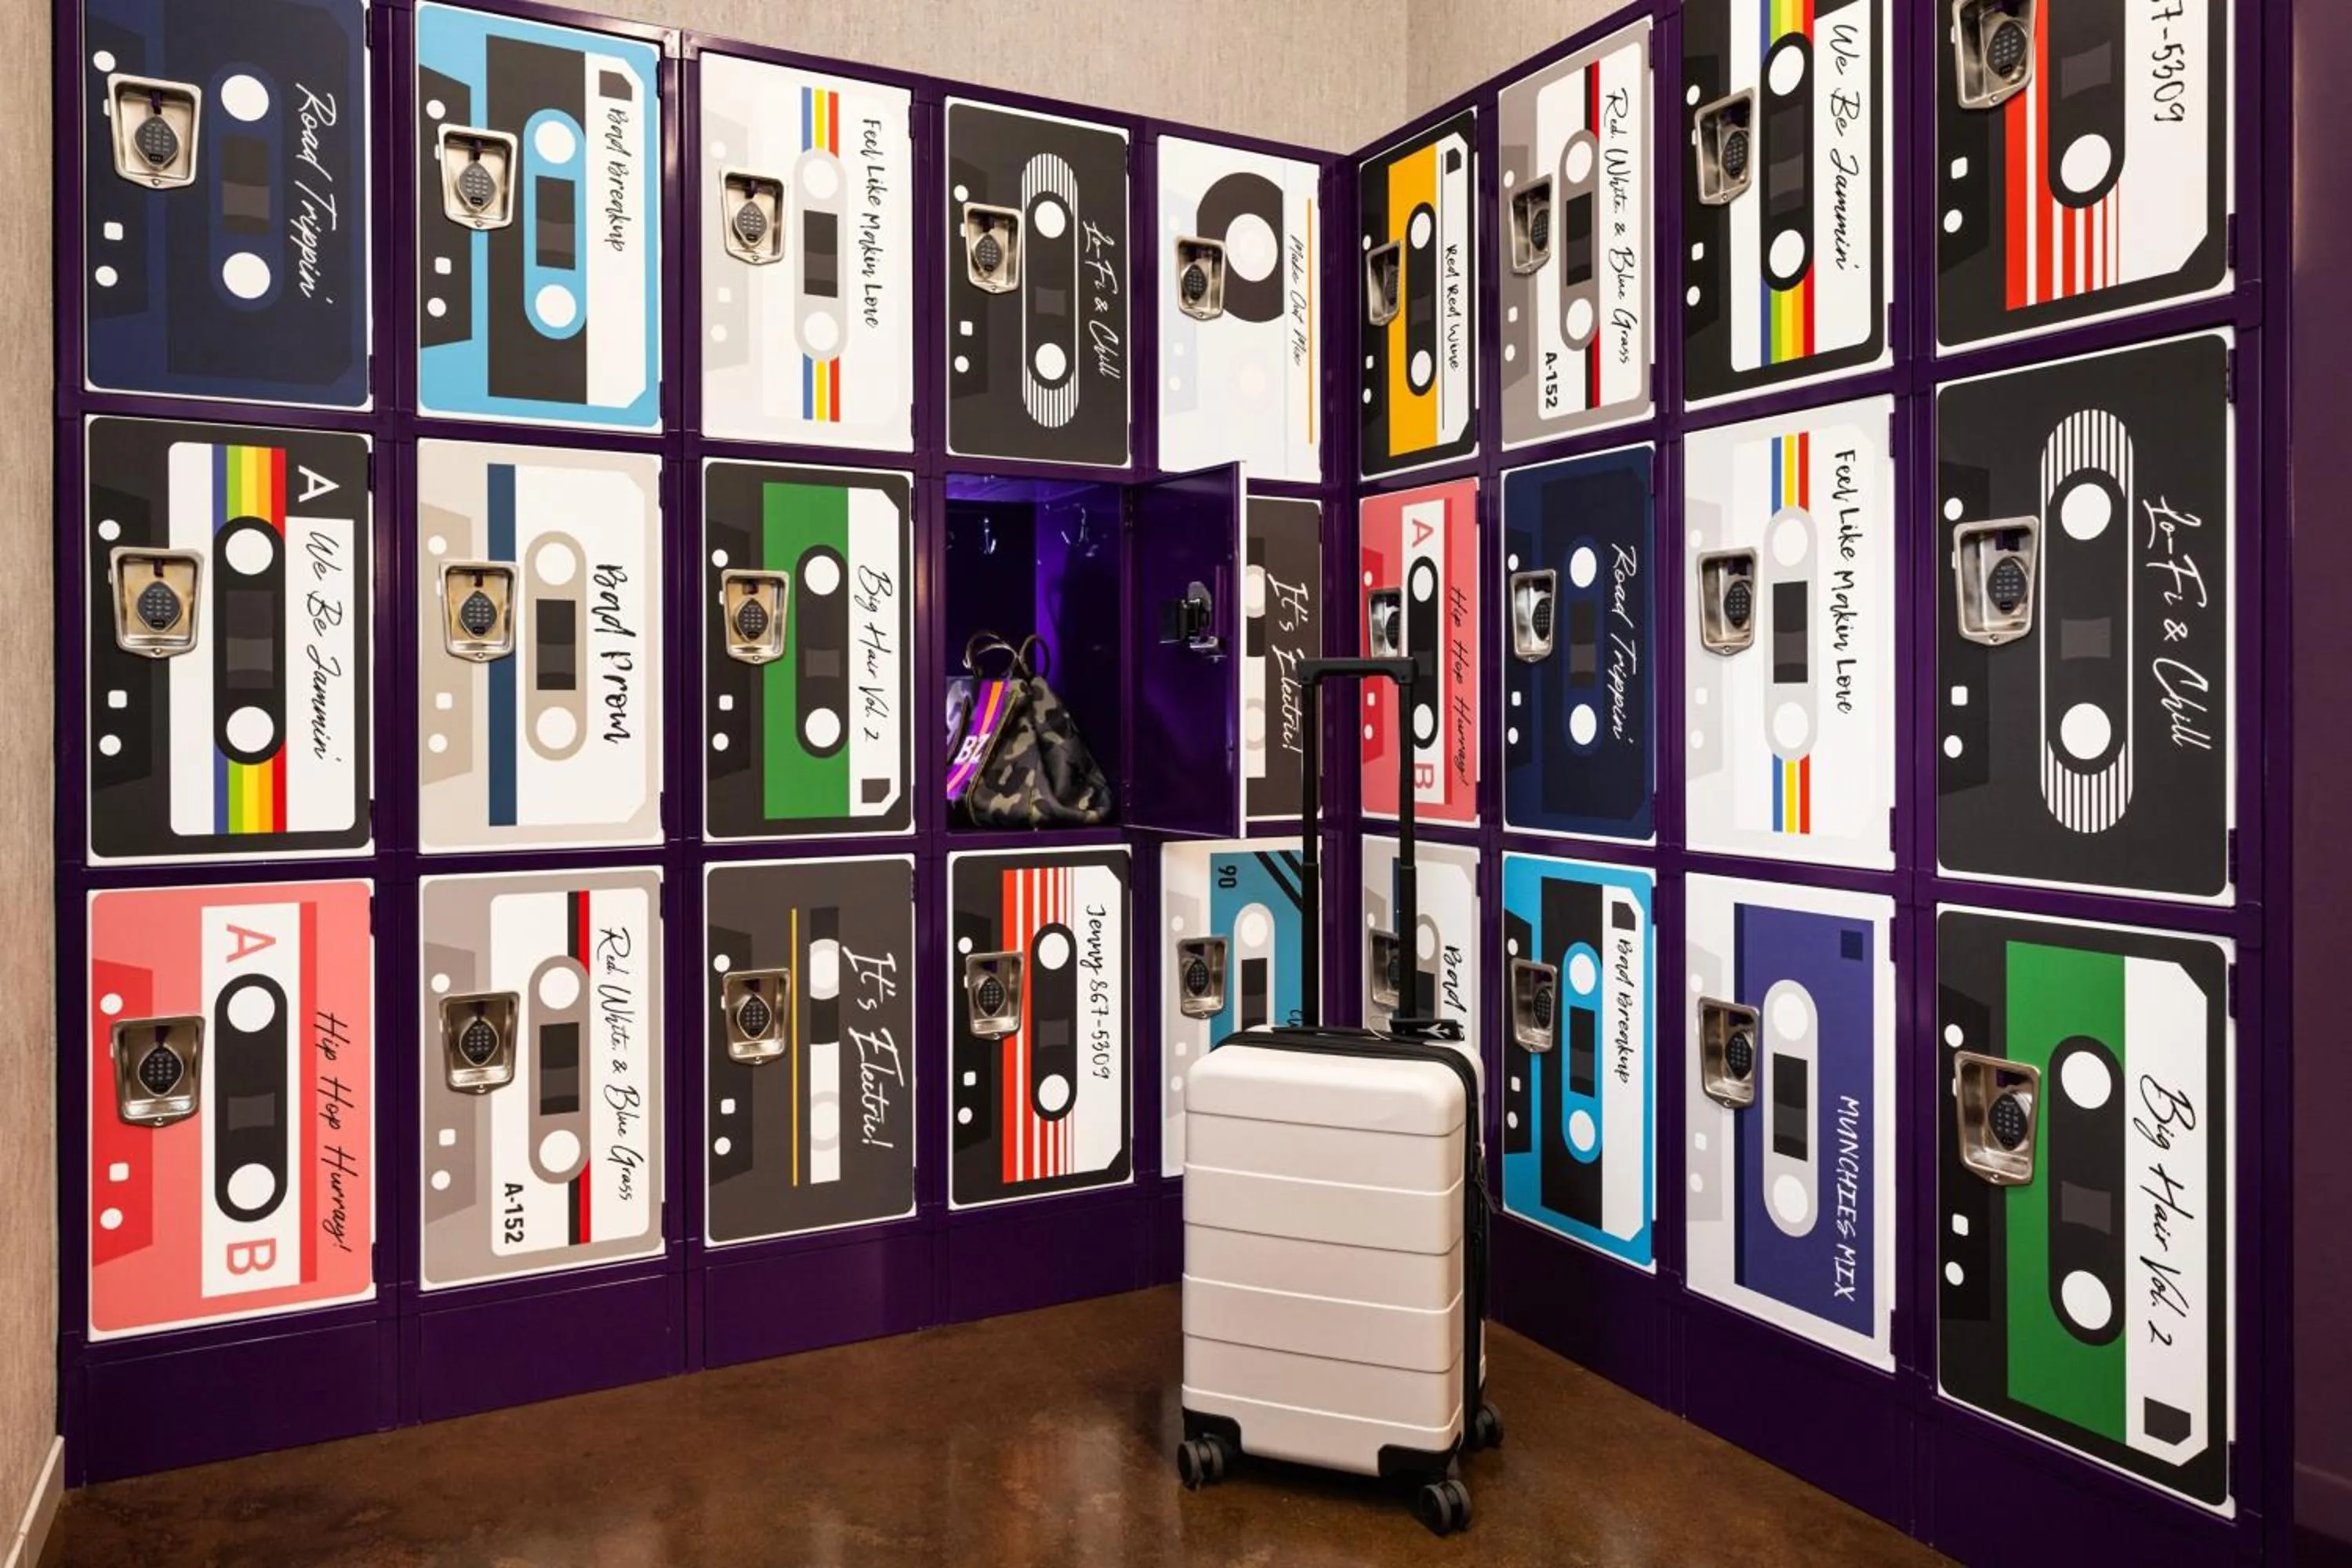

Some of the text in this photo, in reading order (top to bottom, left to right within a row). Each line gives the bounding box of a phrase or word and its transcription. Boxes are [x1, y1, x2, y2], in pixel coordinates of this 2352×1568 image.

[2151, 0, 2185, 122] 7-5309
[290, 83, 337, 303] Road Trippin'
[604, 108, 632, 251] Bad Breakup
[1830, 25, 1860, 270] We Be Jammin'
[858, 119, 888, 326] Feel Like Makin Love
[1607, 246, 1635, 299] Blue
[1615, 223, 1625, 235] &
[1083, 221, 1120, 379] Lo-Fi & Chill
[1289, 234, 1307, 366] Make Out Mix
[1445, 244, 1462, 372] Red Red Wine
[1610, 307, 1639, 365] Grass
[1546, 352, 1558, 408] A-152
[299, 465, 339, 502] A
[1412, 519, 1434, 548] A
[306, 532, 342, 761] We Be Jammin'
[855, 565, 892, 740] Big Hair Vol. 2
[1609, 543, 1636, 742] Road Trippin'
[1830, 449, 1863, 713] Feel Like Makin Love
[2143, 495, 2211, 750] Lo-Fi & Chill
[591, 564, 637, 743] Bad Prom
[1266, 572, 1309, 753] It's Electric!
[1449, 586, 1472, 787] Hip Hop Hurray!
[1414, 763, 1435, 789] B
[226, 924, 276, 963] A
[1218, 866, 1236, 888] 90
[842, 946, 904, 1148] It's Electric!
[1080, 905, 1110, 1079] Jenny 867-5309
[1443, 946, 1467, 1013] Bad
[1614, 939, 1634, 1083] Bad Breakup
[314, 1011, 359, 1253] Hip Hop Hurray!
[604, 1084, 640, 1136] Blue
[612, 1060, 627, 1073] &
[505, 1183, 524, 1243] A-152
[607, 1145, 644, 1200] Grass
[1834, 1096, 1859, 1301] MUNCHIES MIX
[2133, 1075, 2195, 1346] Big Hair Vol. 2
[227, 1238, 276, 1275] B
